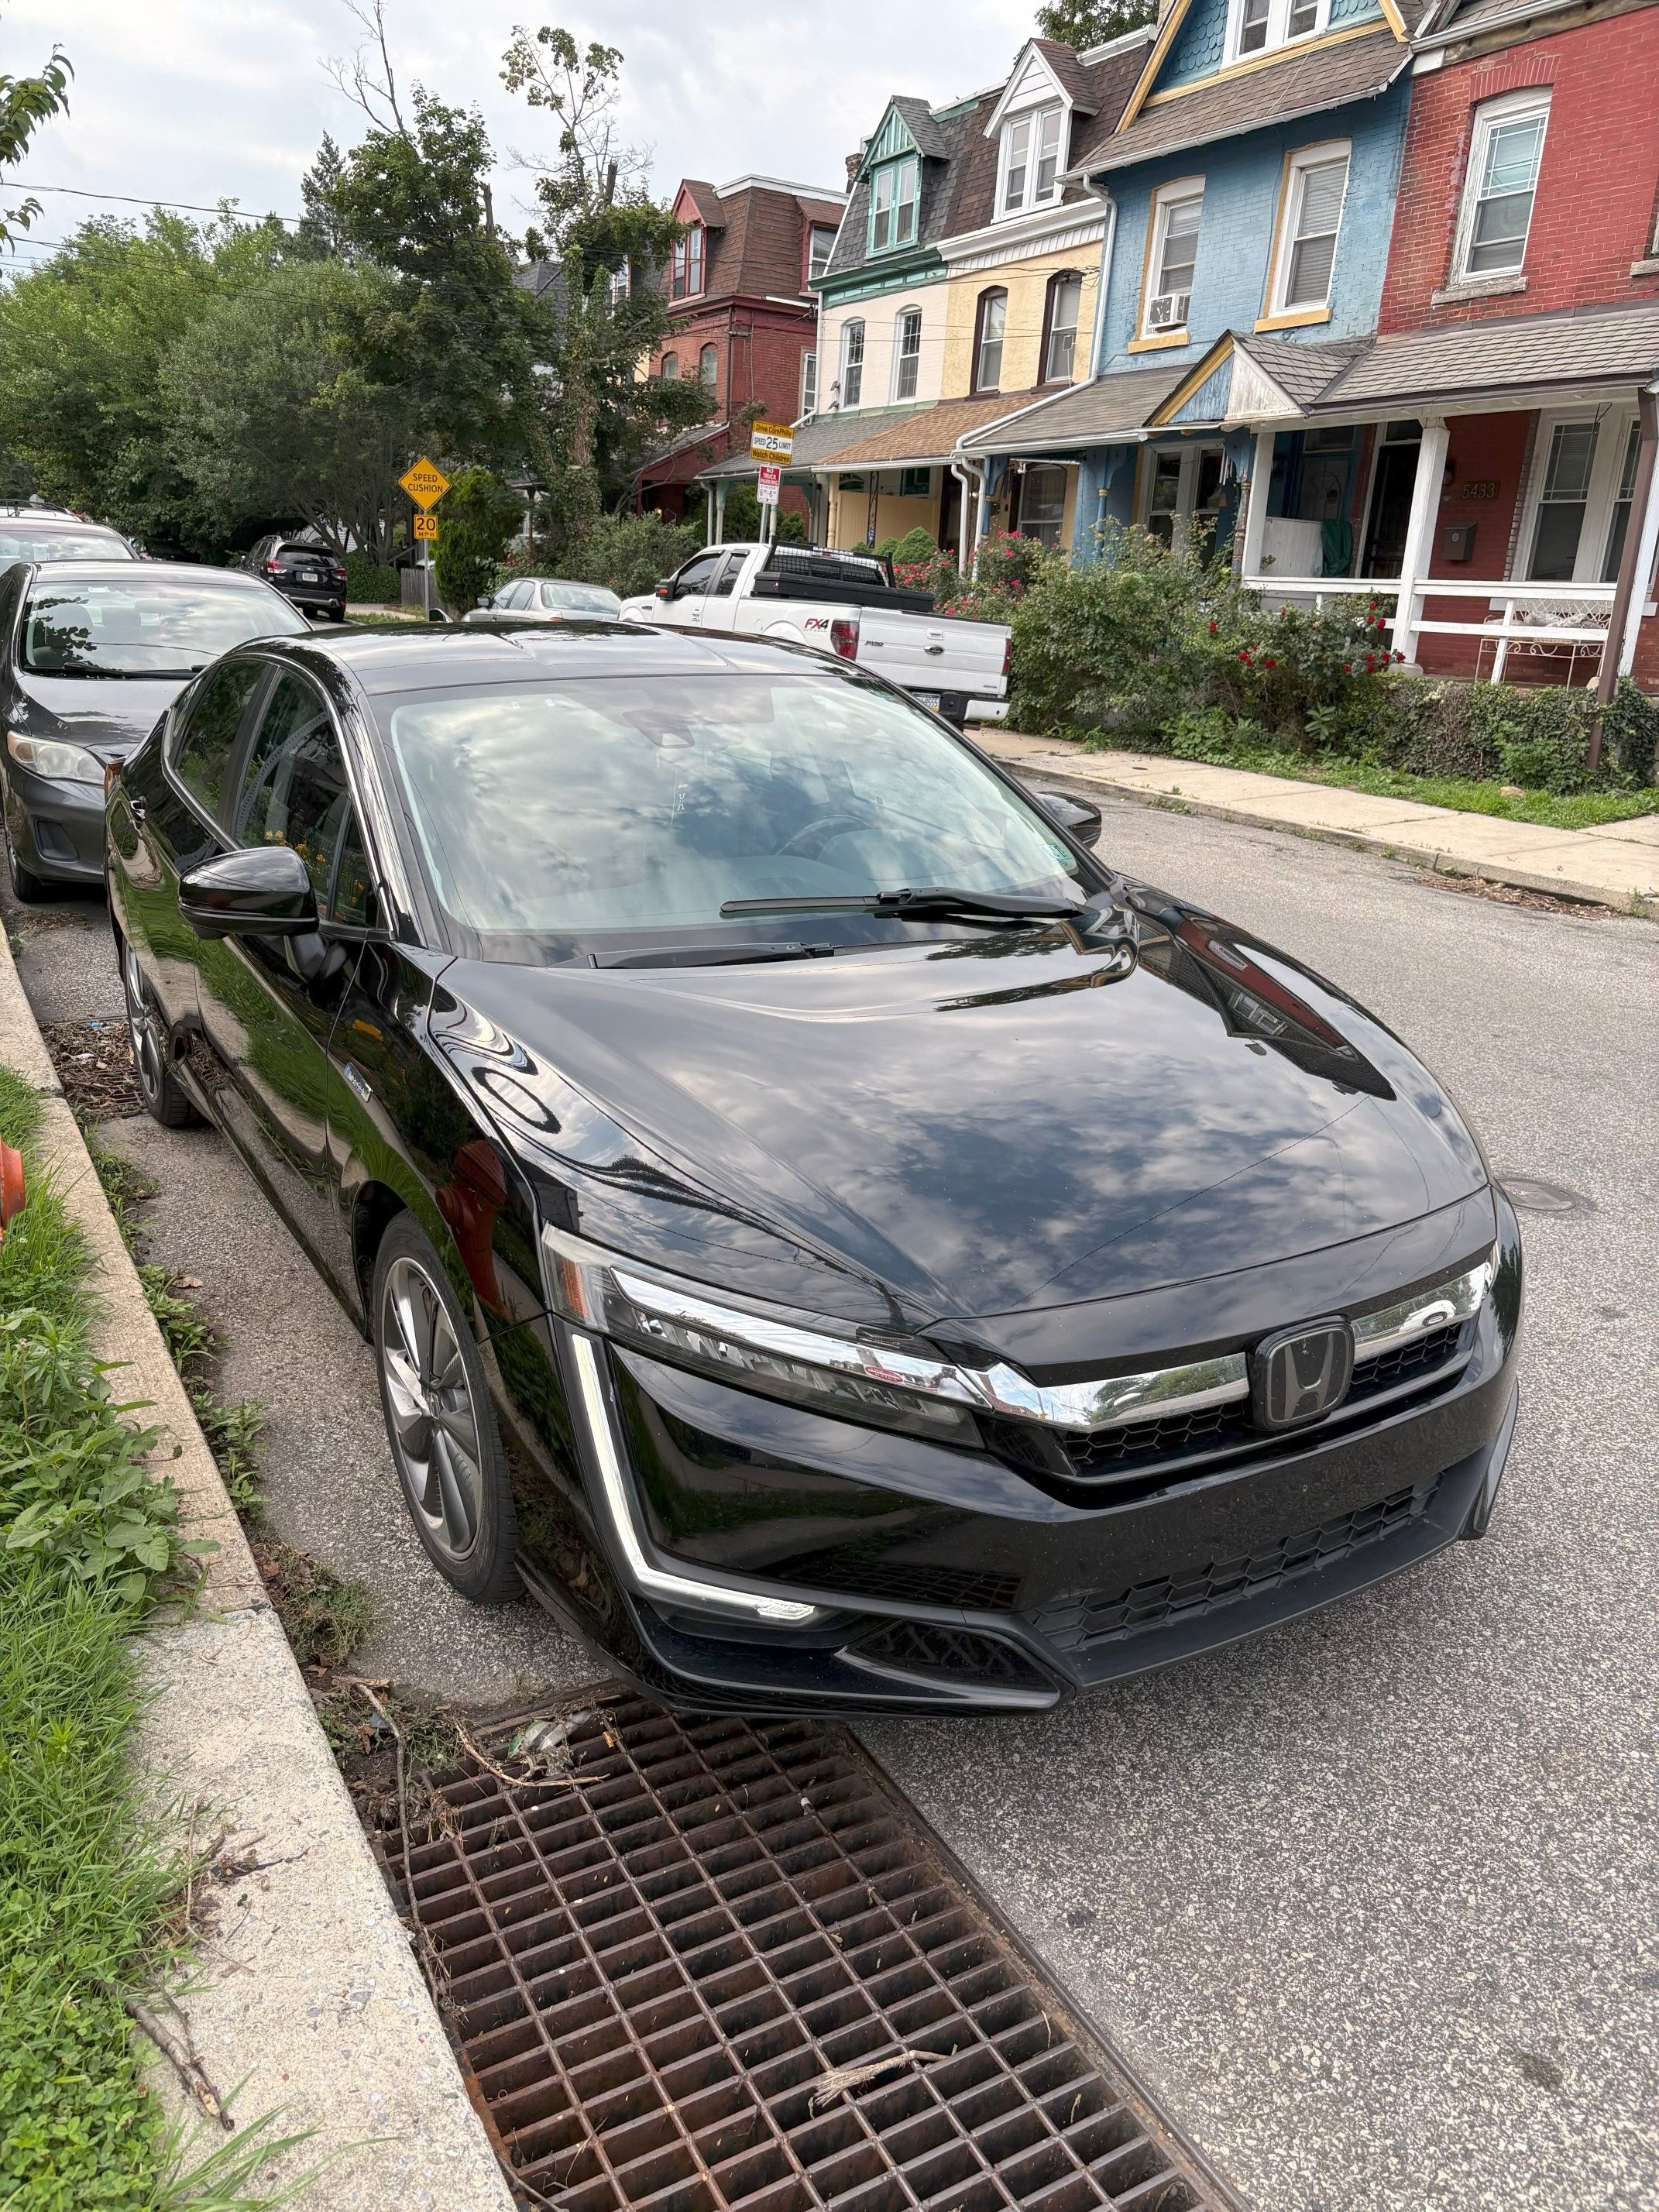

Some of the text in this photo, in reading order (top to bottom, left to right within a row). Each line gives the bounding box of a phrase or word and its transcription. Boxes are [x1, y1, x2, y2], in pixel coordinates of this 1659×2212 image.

[756, 424, 768, 433] Drive
[754, 436, 792, 450] SPEED 25 LIMIT
[752, 450, 790, 463] Watch Children
[413, 473, 438, 482] SPEED
[407, 483, 443, 493] CUSHION
[1462, 483, 1496, 499] 5433
[417, 517, 435, 531] 20
[804, 618, 830, 630] FX4
